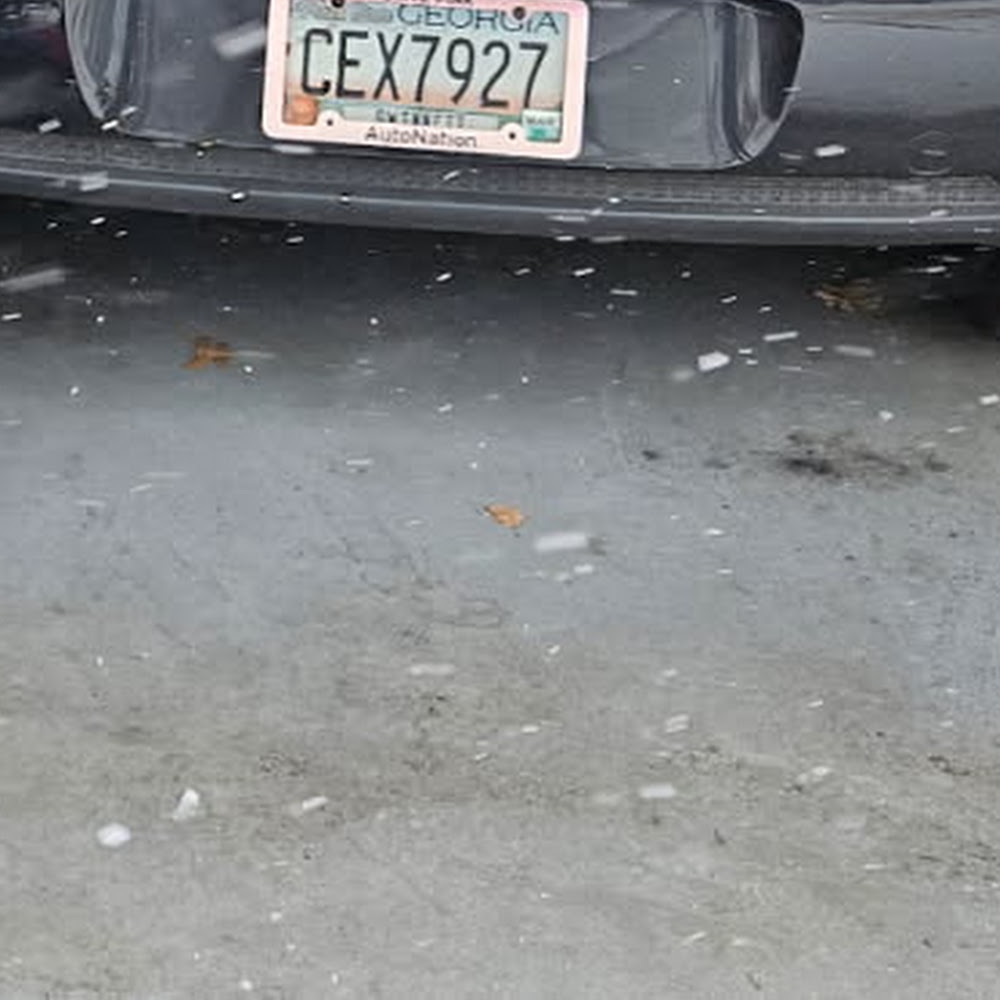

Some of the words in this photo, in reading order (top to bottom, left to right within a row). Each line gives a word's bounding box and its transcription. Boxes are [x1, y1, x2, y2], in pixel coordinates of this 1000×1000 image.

[397, 3, 560, 34] GEORGIA
[301, 28, 549, 109] CEX7927
[364, 125, 478, 148] AutoNation
